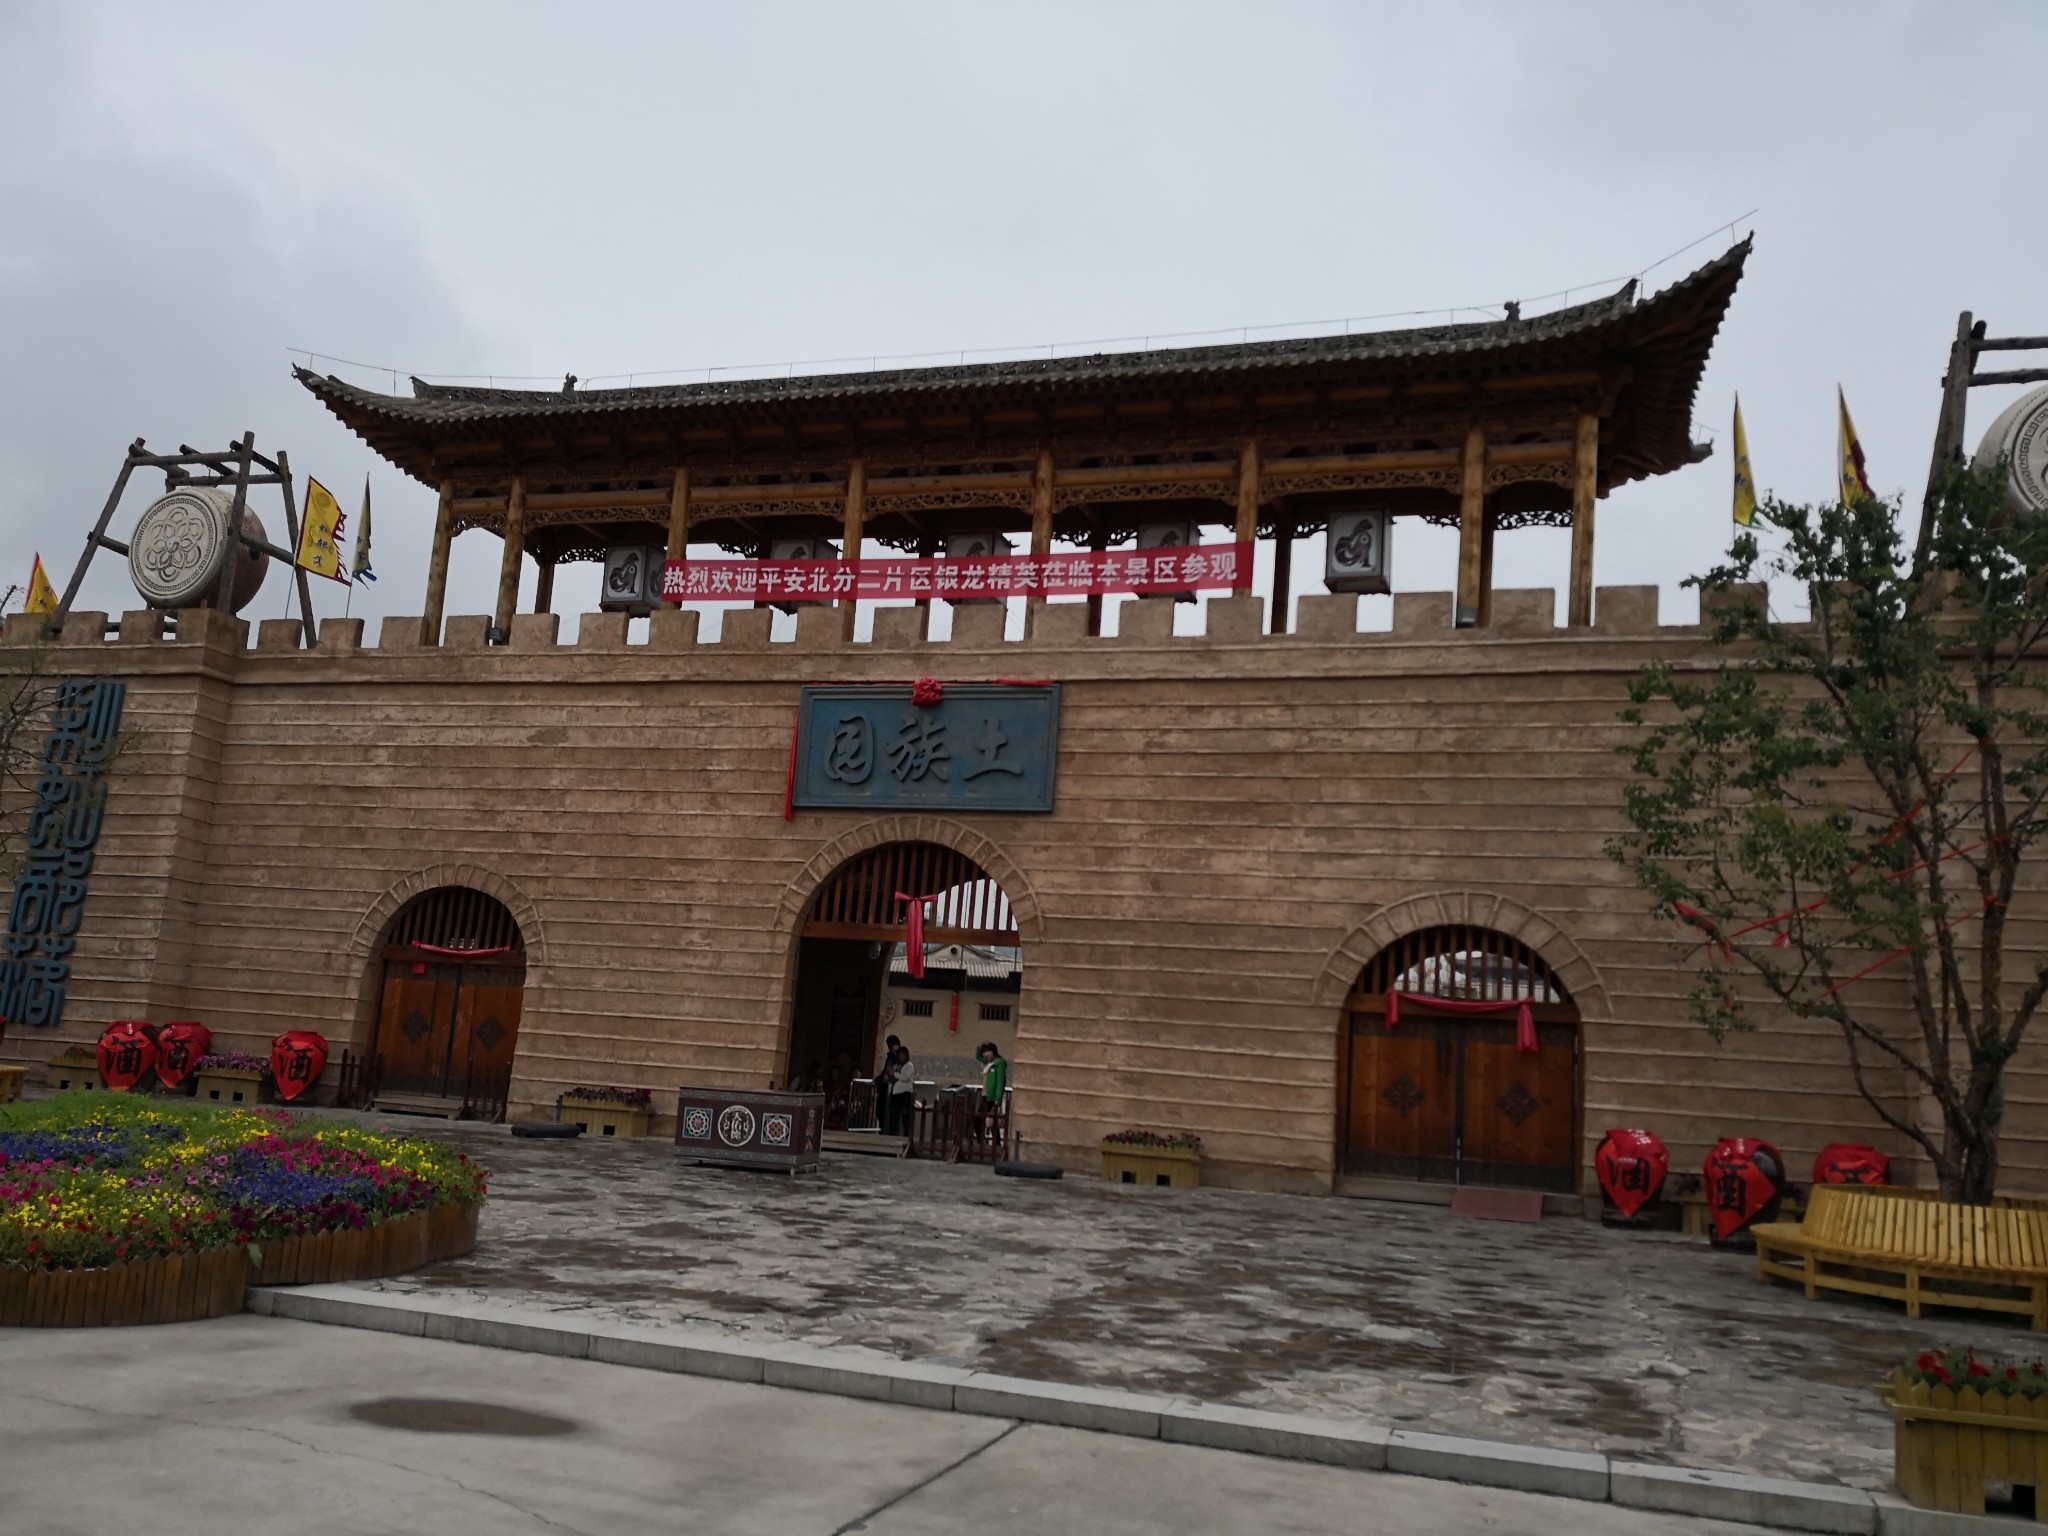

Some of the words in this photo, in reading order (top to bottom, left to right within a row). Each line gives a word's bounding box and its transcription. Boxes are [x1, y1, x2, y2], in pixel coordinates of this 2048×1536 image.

[663, 552, 1239, 595] 热烈欢迎平安北分二片区银龙精英莅临本景区参观
[104, 1037, 145, 1077] 酒
[278, 1042, 314, 1083] 酒
